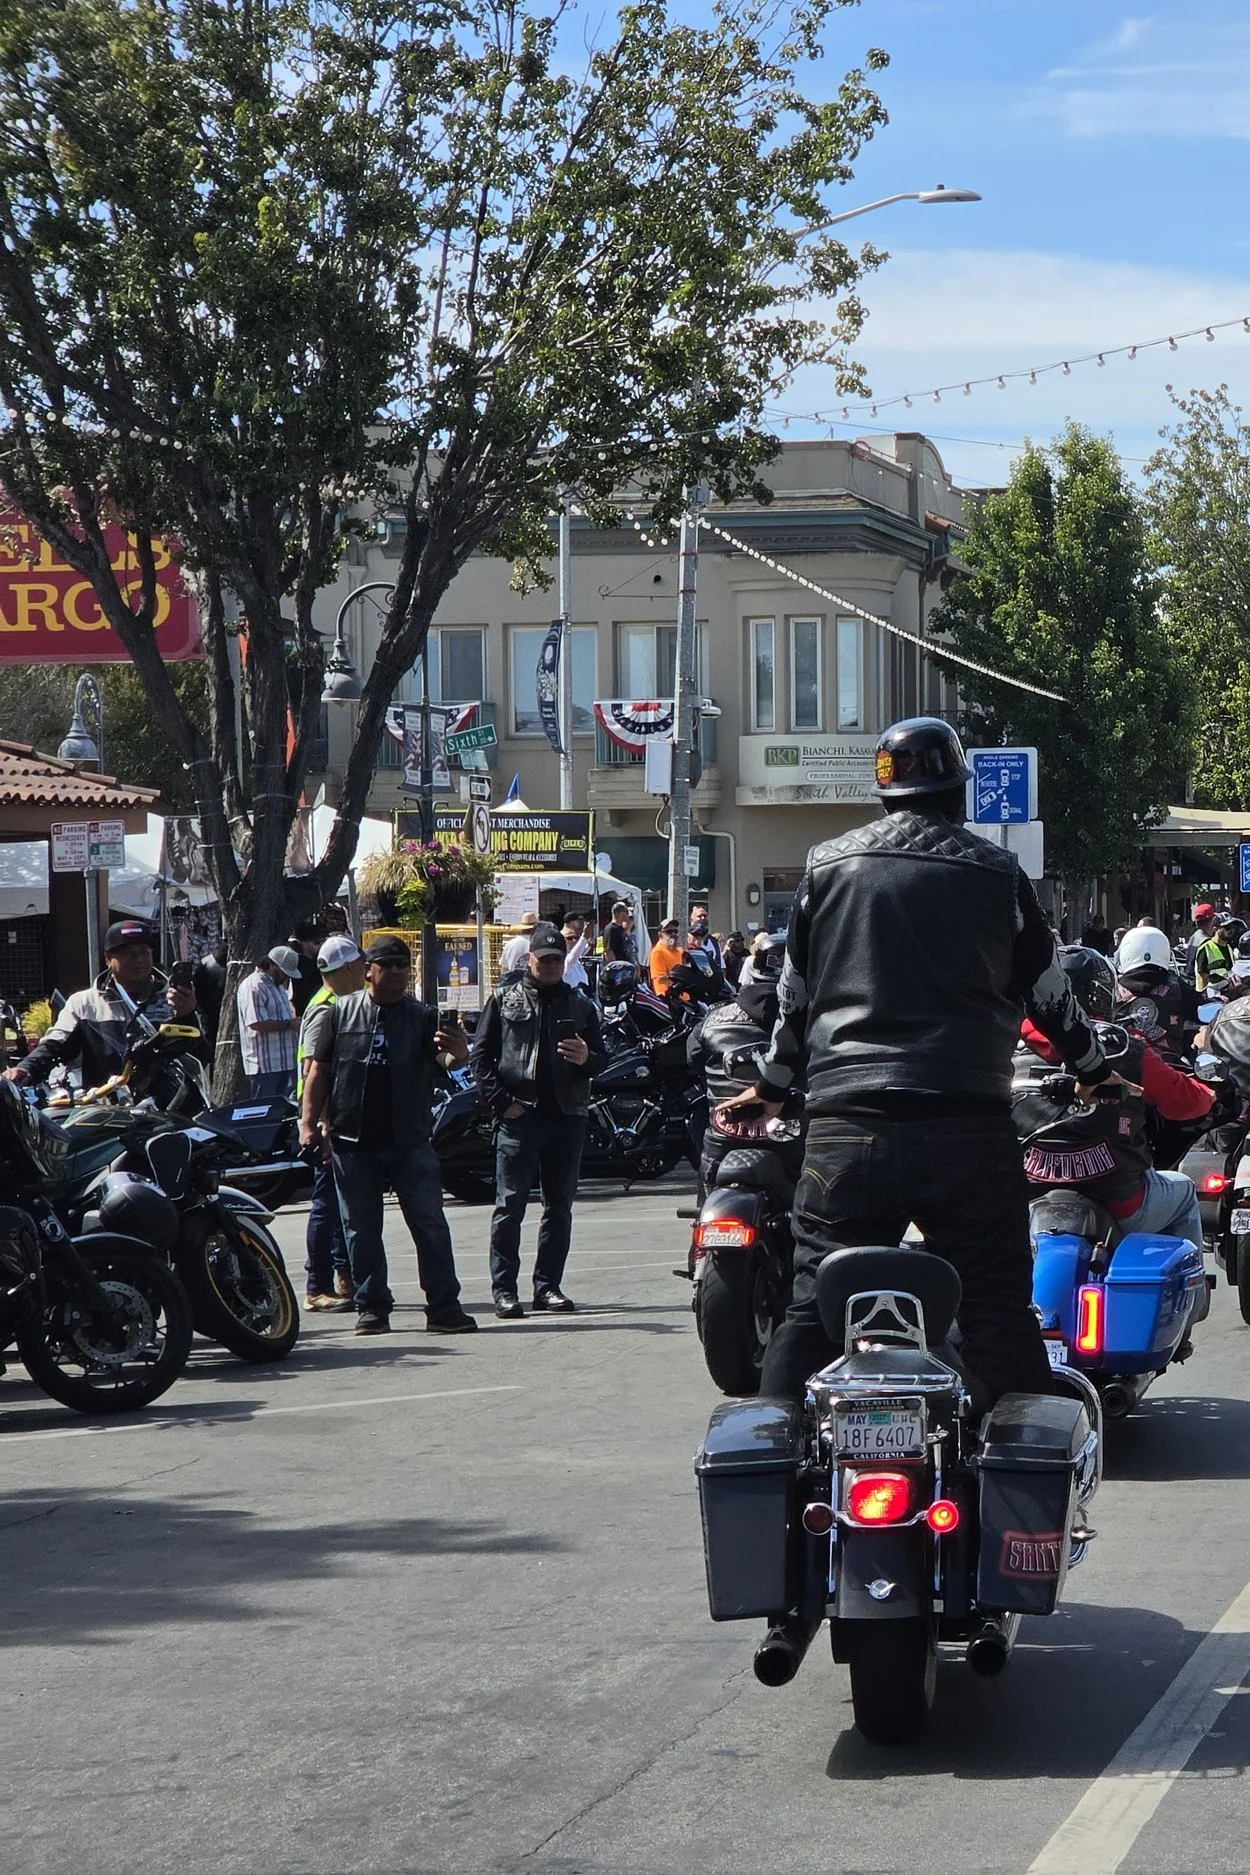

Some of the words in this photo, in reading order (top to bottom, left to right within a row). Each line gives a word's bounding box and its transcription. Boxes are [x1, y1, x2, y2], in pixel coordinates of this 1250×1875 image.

[0, 579, 171, 632] RGO
[448, 734, 477, 751] Sixth
[437, 818, 464, 829] OFFICI
[498, 818, 551, 829] MERCHANDISE
[510, 831, 559, 852] COMPANY
[847, 1415, 867, 1425] MAY
[853, 1452, 905, 1460] CALIFORNIA
[1009, 1541, 1061, 1572] SANT
